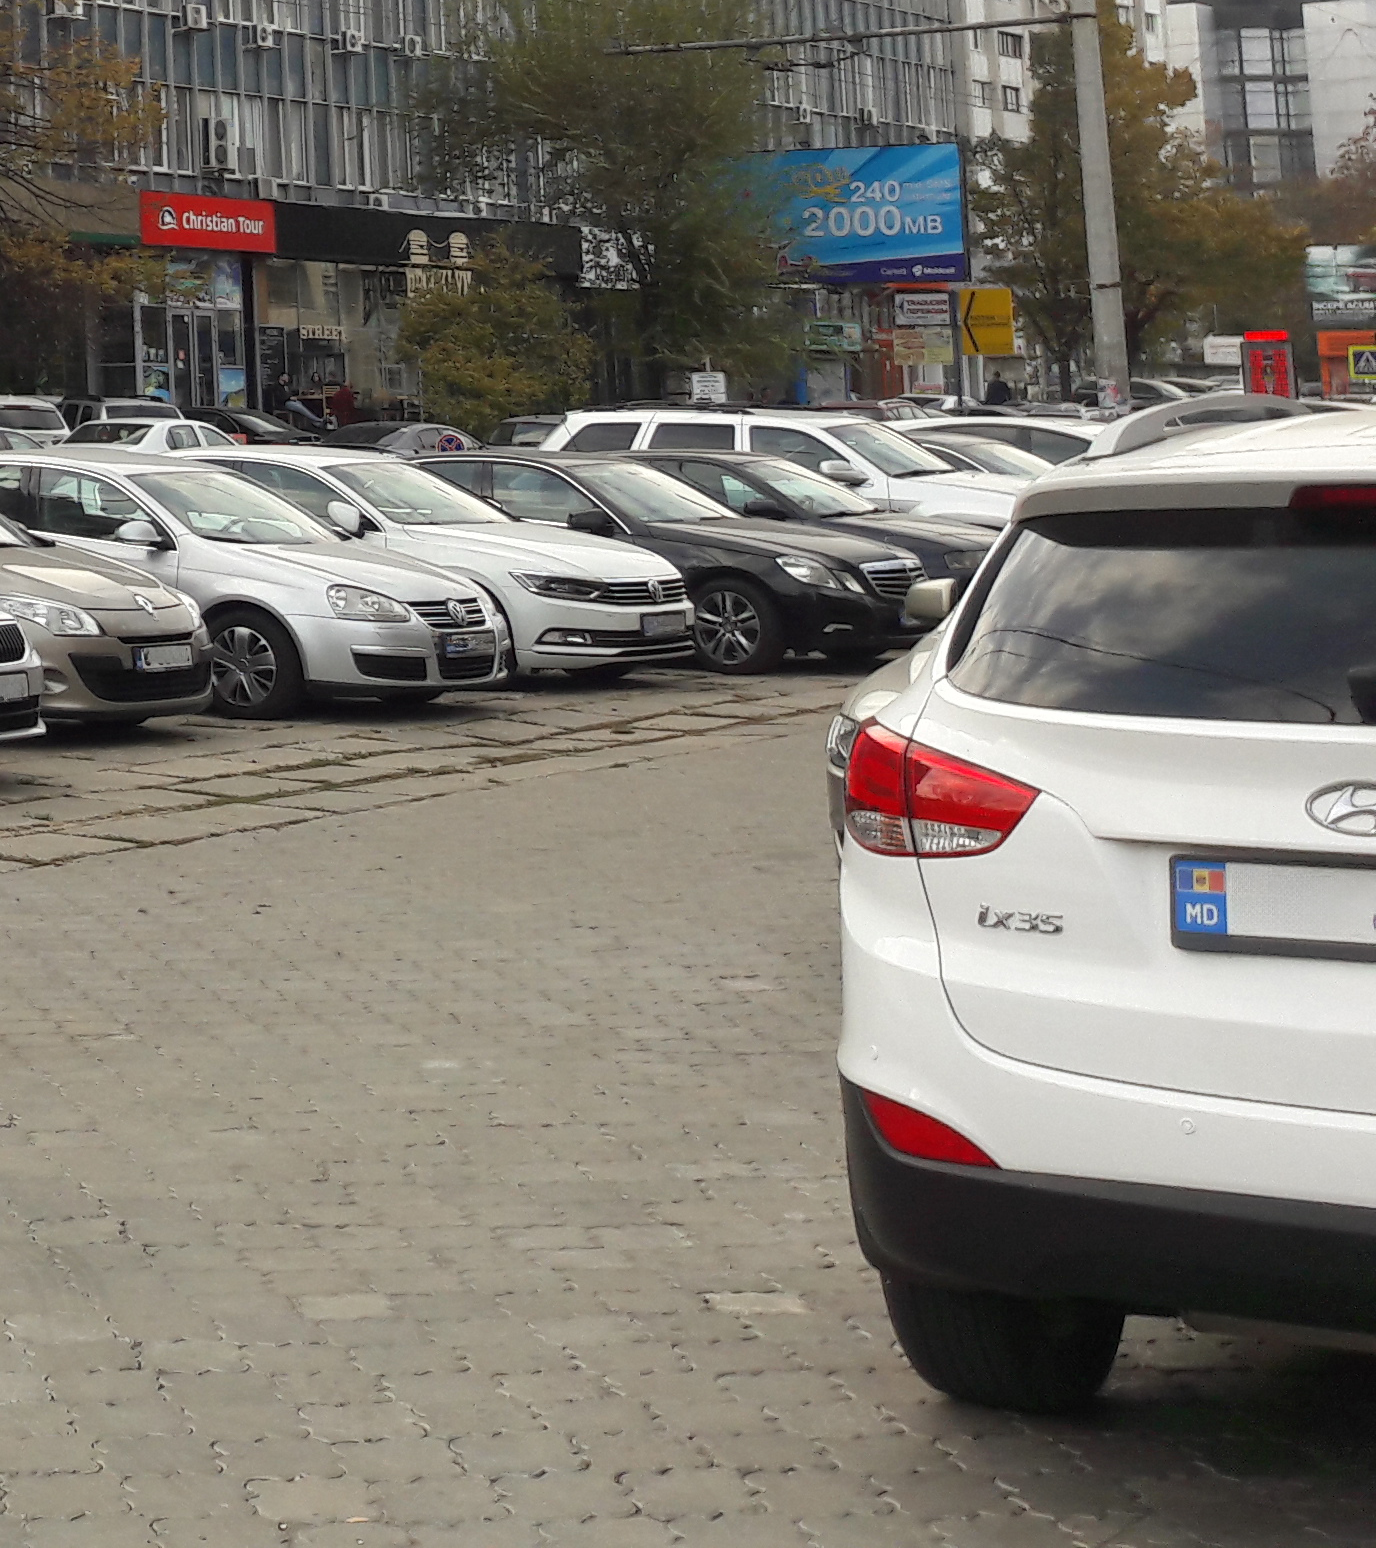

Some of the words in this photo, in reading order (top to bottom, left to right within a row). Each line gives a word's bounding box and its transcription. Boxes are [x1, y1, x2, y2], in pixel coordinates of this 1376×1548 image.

[850, 181, 900, 202] 240
[182, 210, 236, 233] Christian
[237, 217, 265, 234] Tour
[802, 205, 901, 237] 2000
[904, 215, 943, 234] MB
[977, 902, 1063, 934] ix35
[1185, 902, 1219, 926] MD
